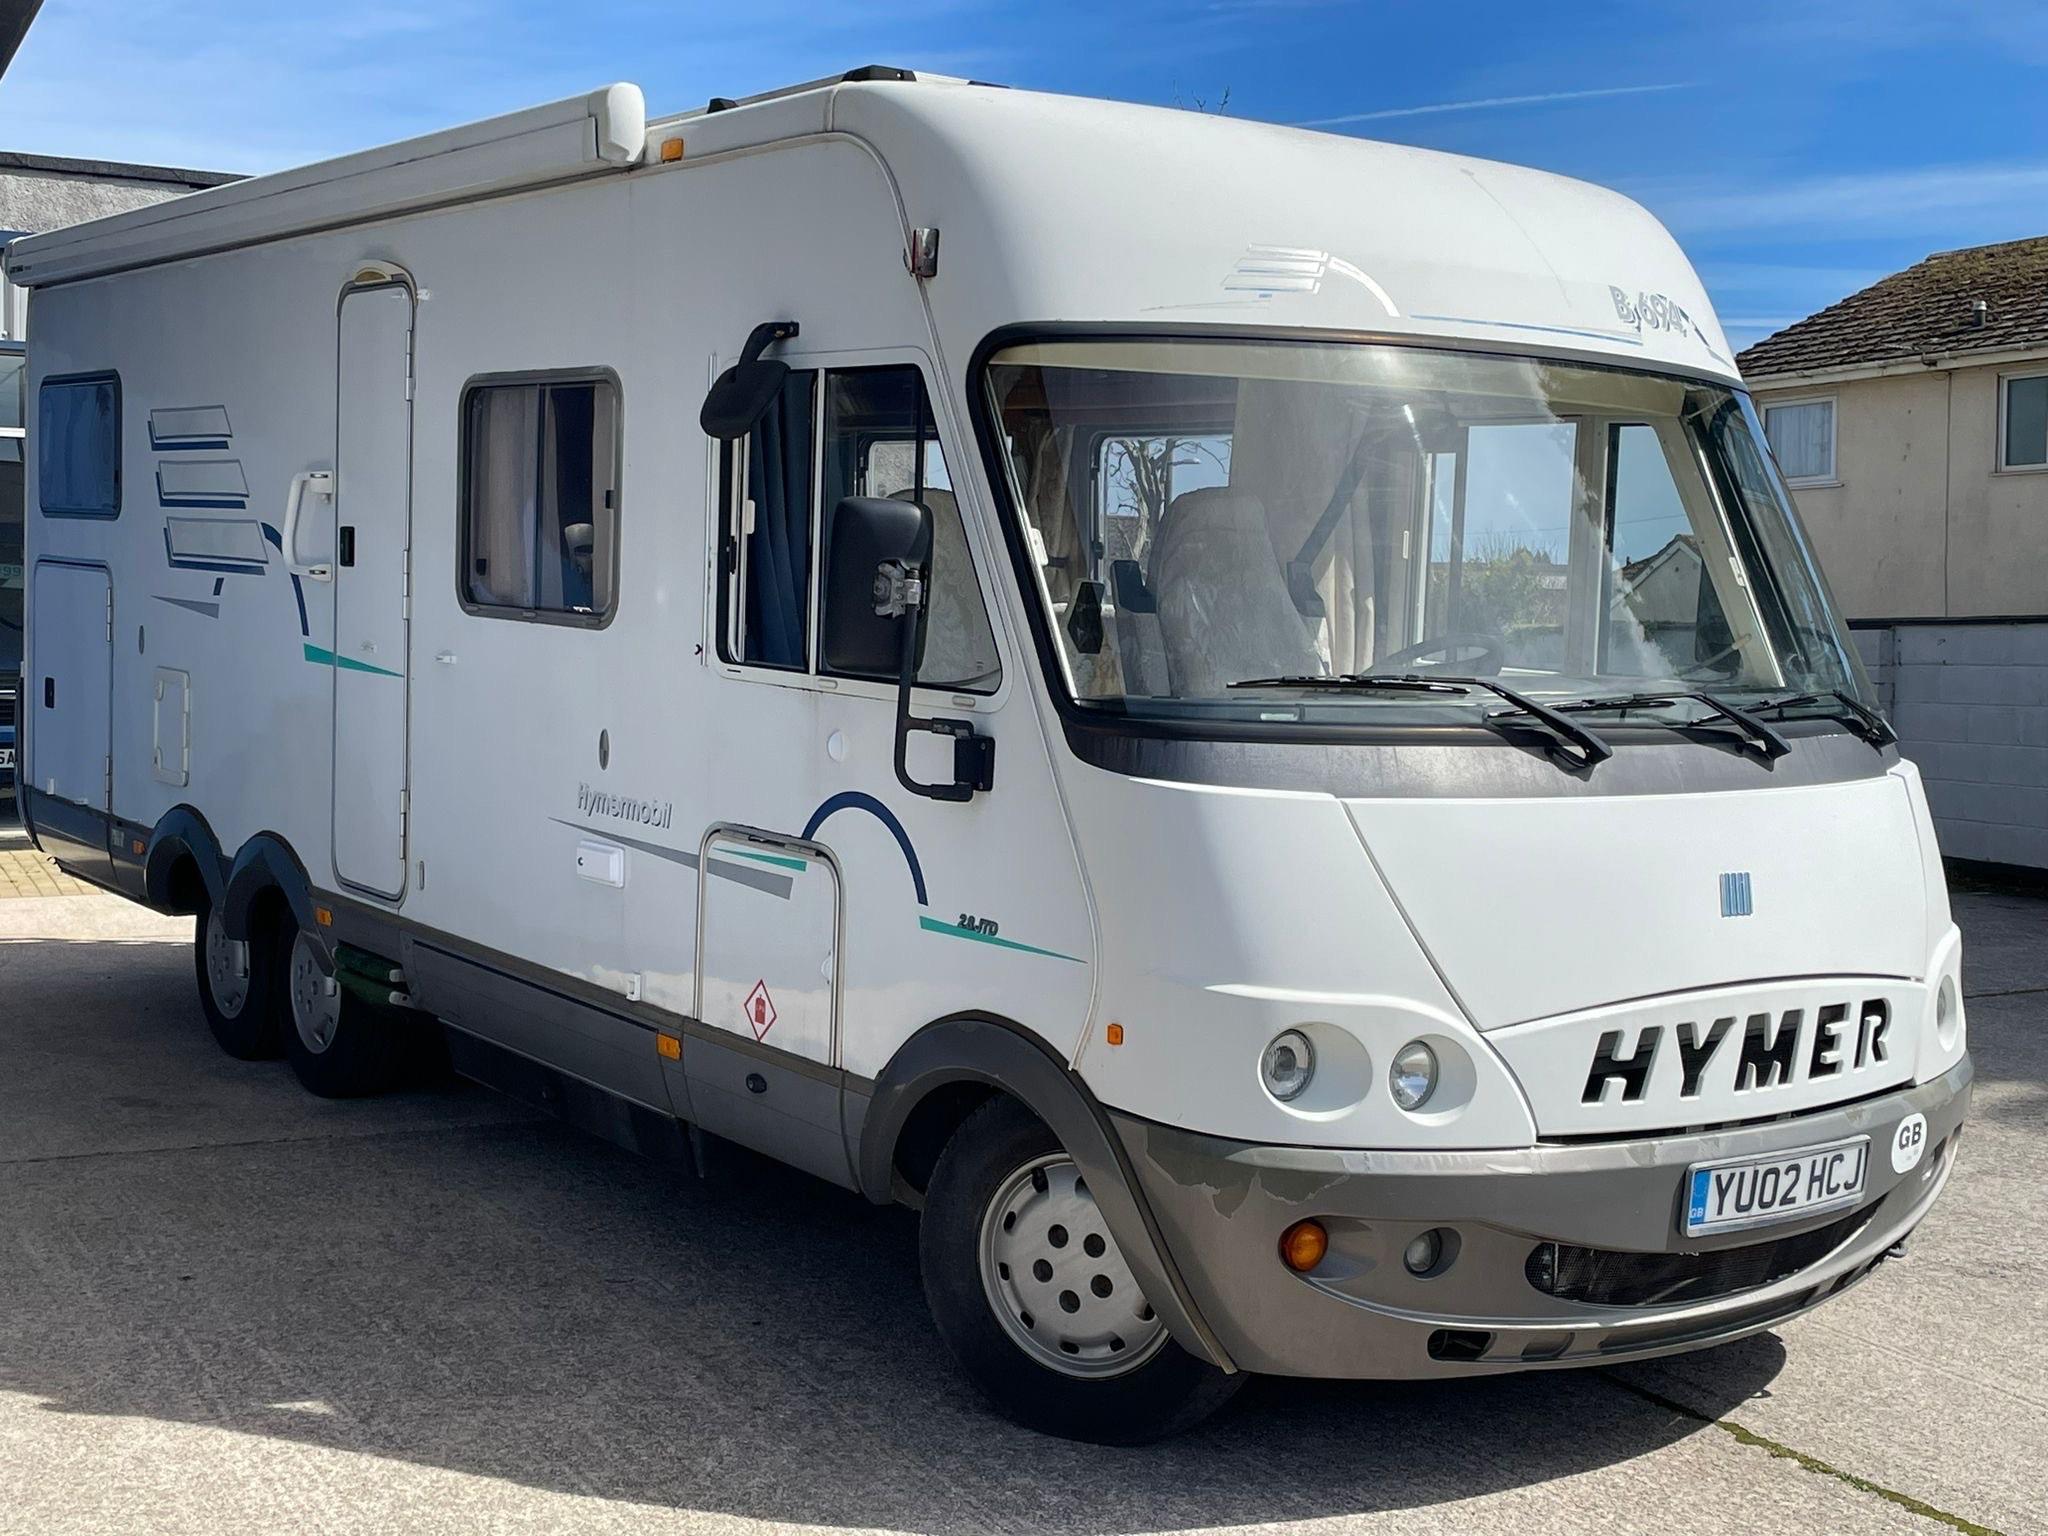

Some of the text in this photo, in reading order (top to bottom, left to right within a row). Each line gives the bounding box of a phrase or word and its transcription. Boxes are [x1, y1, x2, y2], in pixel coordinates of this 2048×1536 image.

[1581, 998, 1893, 1104] HYMER
[1899, 1122, 1922, 1150] GB
[1715, 1148, 1864, 1216] YU02 HCJ
[1690, 1207, 1704, 1217] GB
